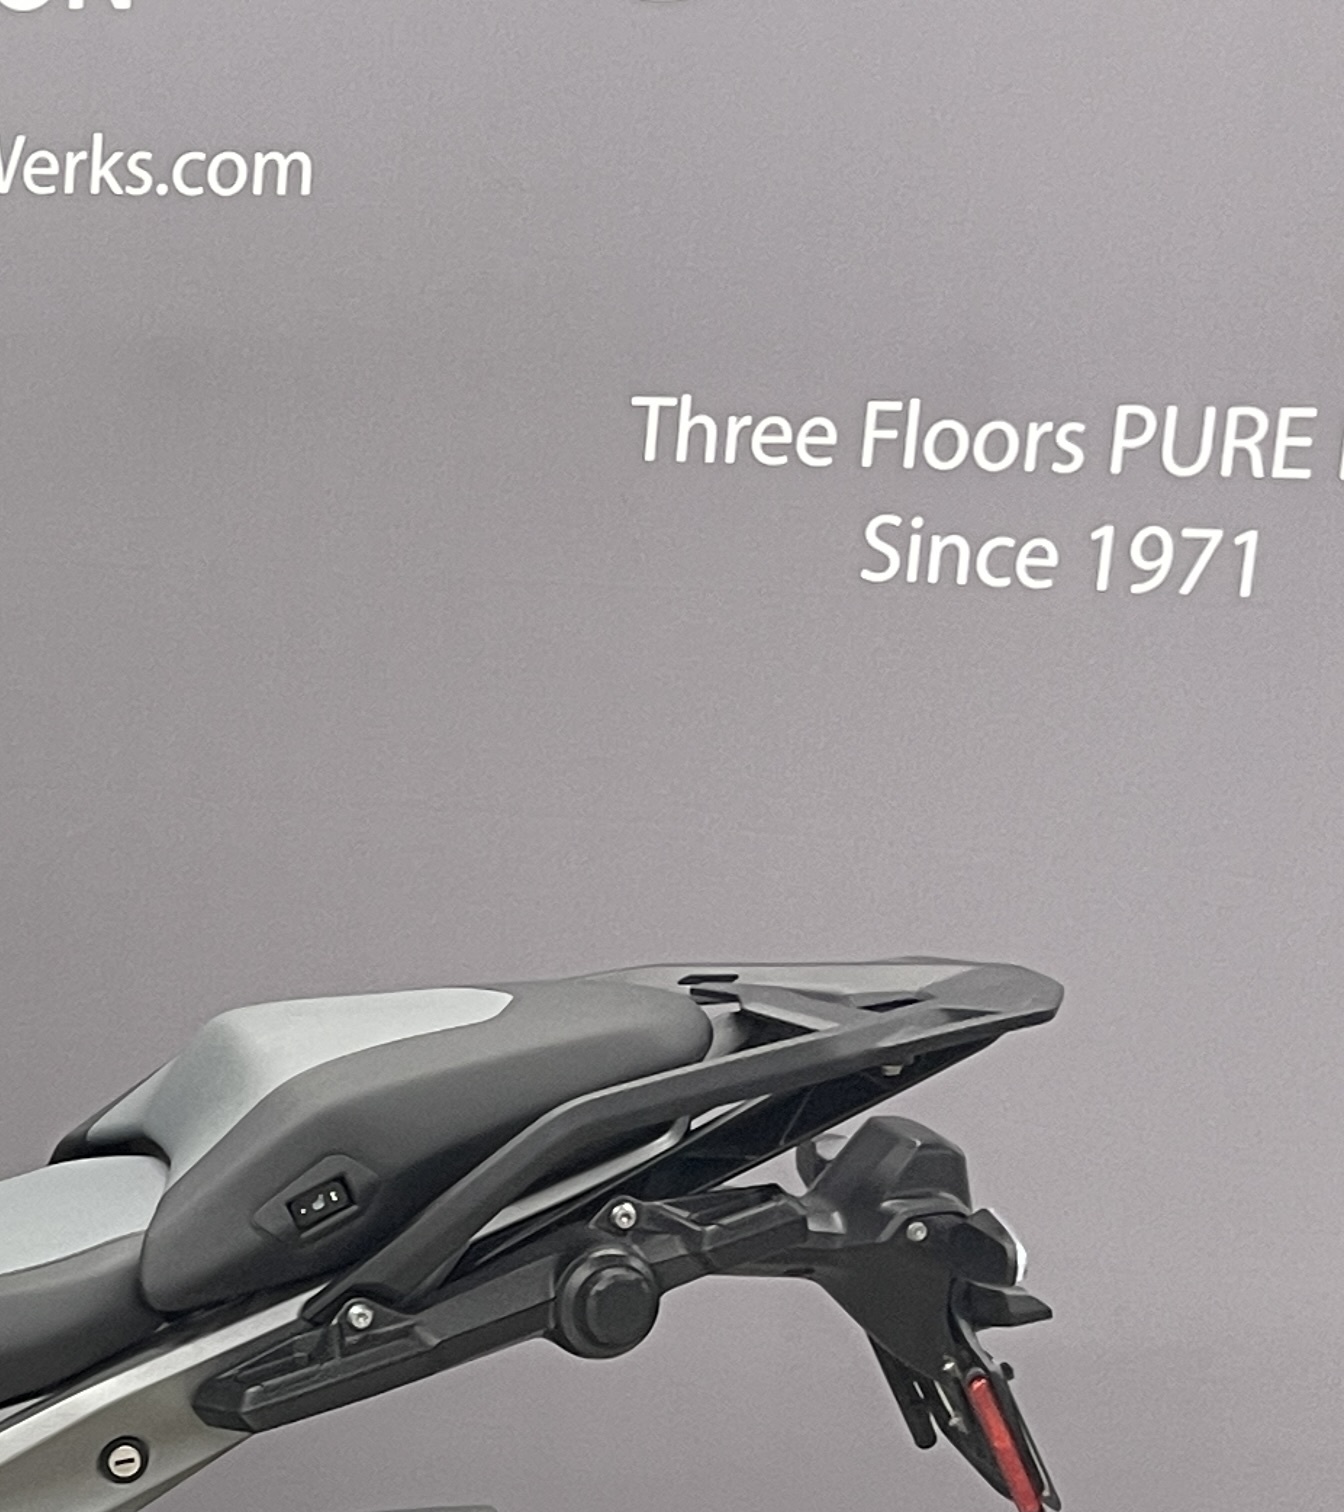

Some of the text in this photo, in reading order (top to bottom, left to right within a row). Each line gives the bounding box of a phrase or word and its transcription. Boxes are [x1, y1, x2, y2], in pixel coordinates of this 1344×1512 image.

[630, 393, 839, 468] Three
[860, 398, 1087, 475] Floors
[1109, 404, 1319, 480] PURE
[859, 514, 1260, 599] Since 1971
